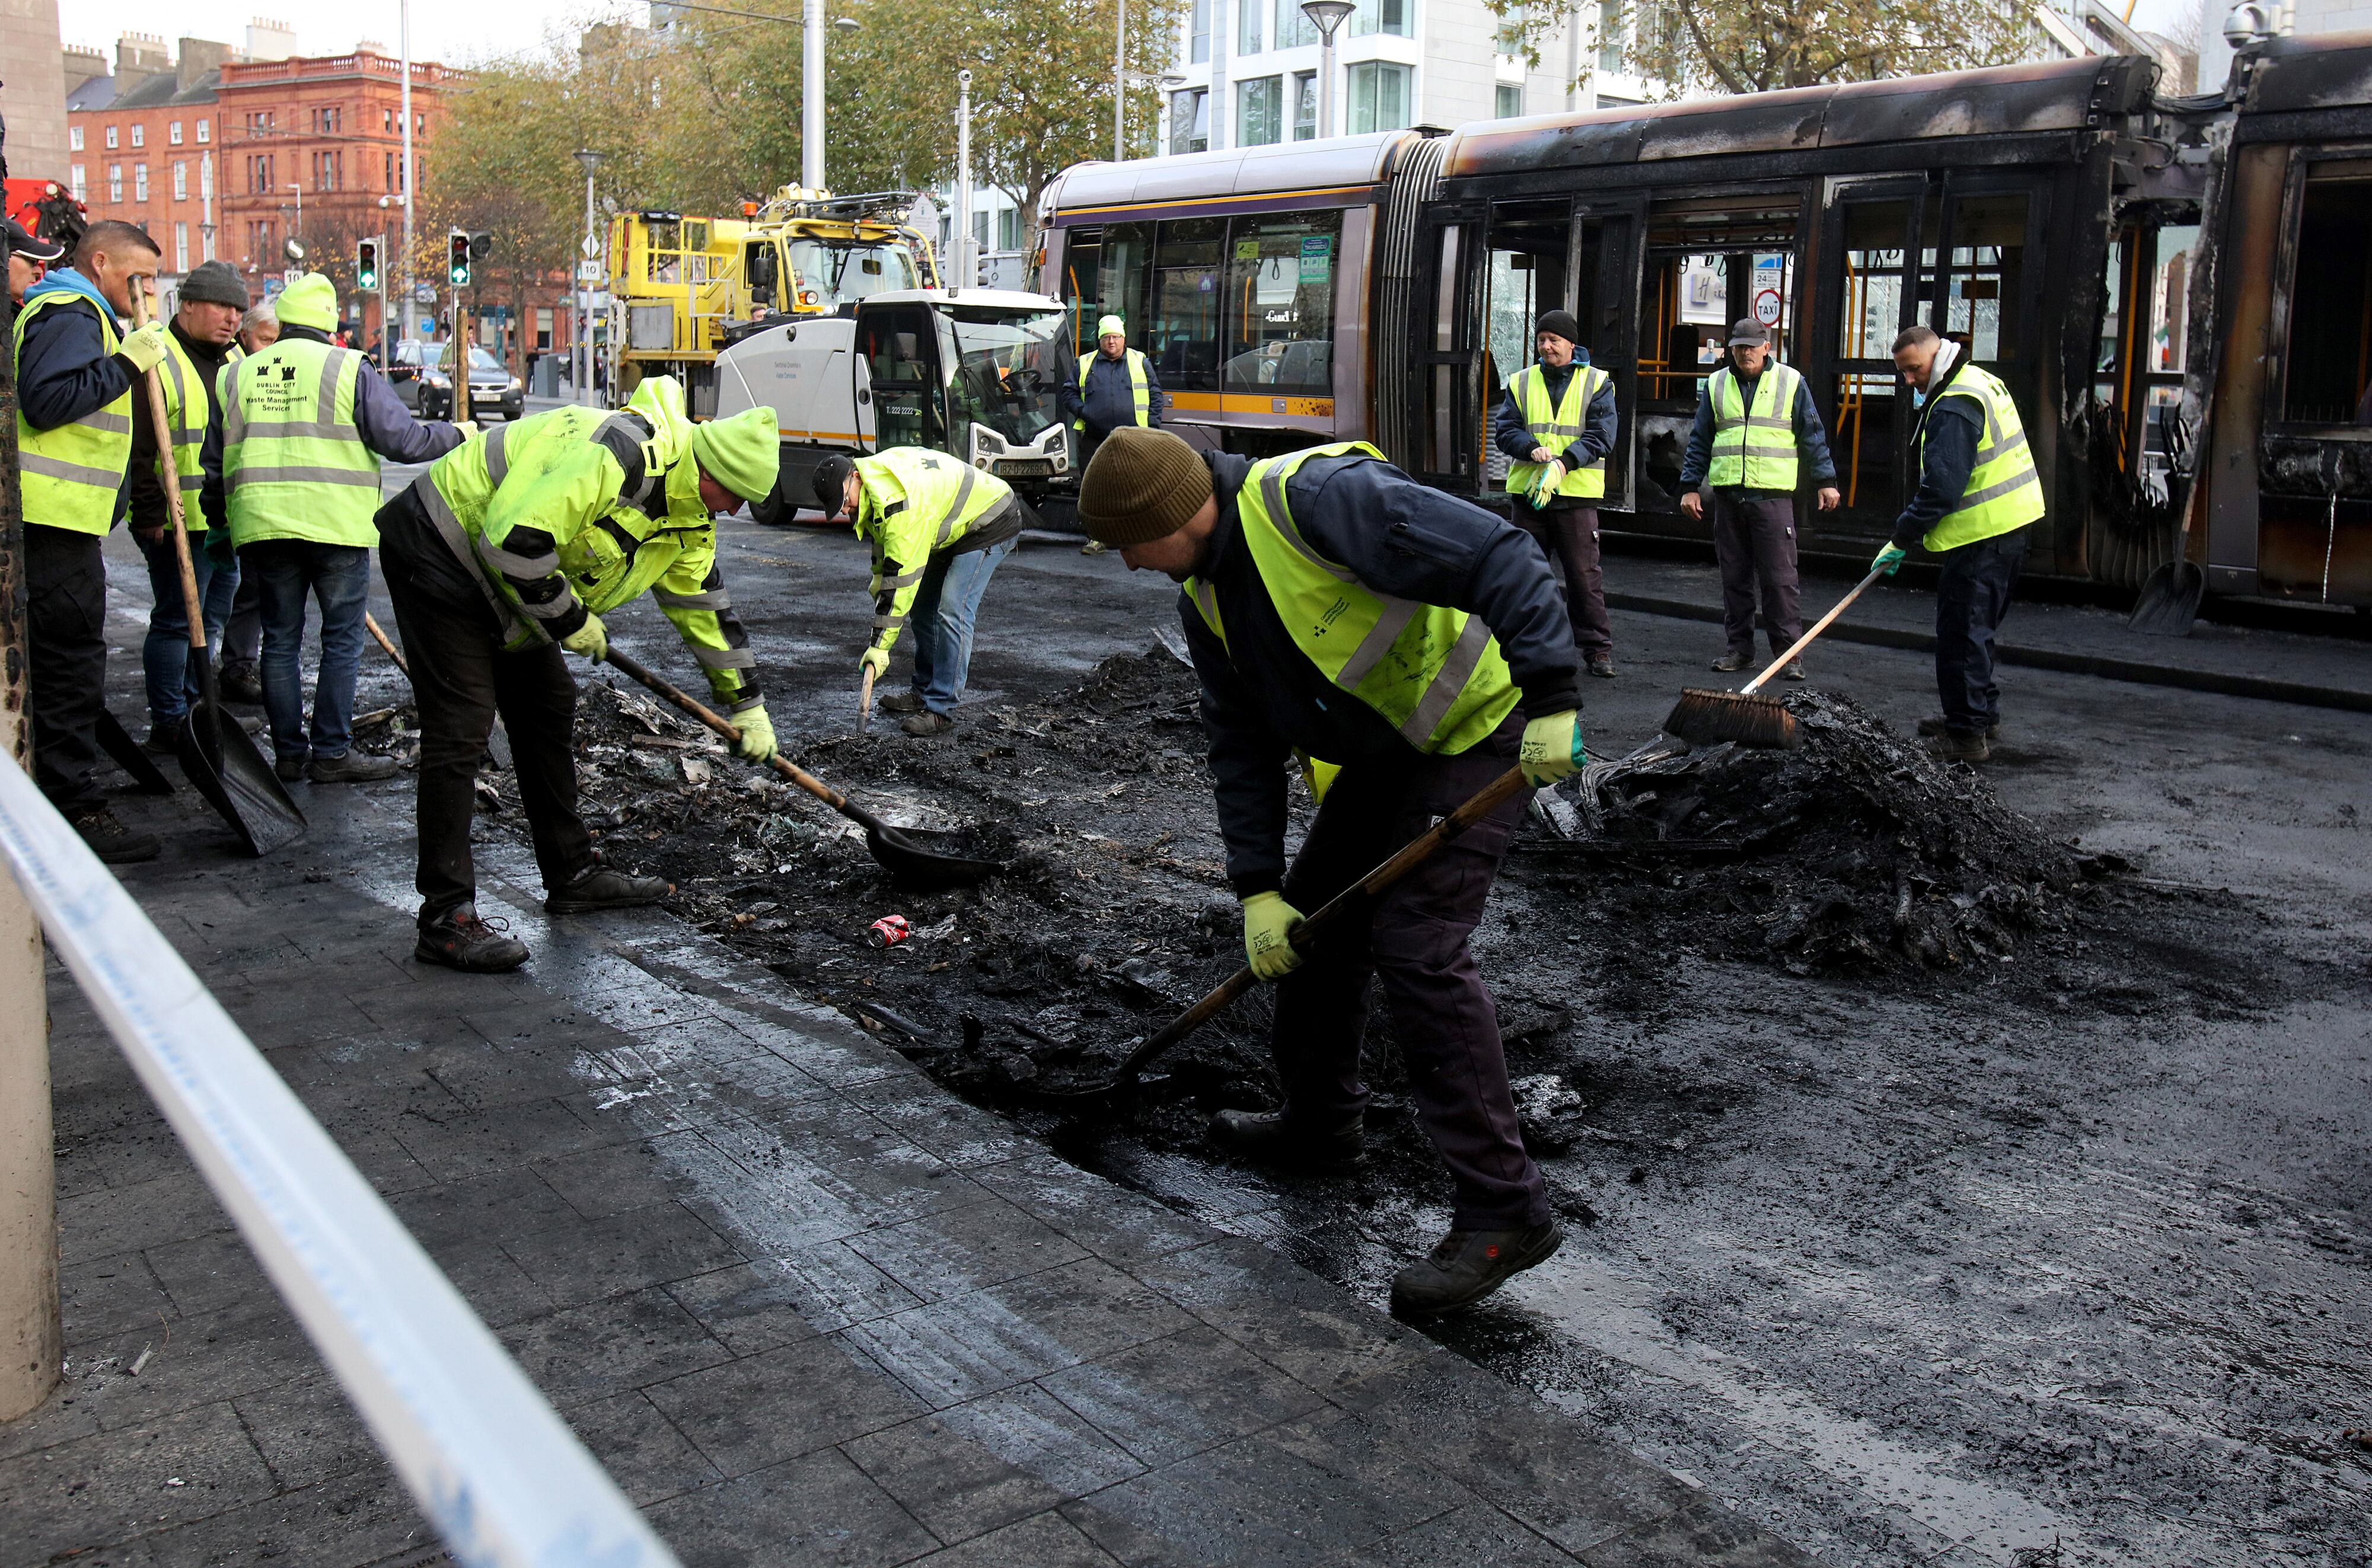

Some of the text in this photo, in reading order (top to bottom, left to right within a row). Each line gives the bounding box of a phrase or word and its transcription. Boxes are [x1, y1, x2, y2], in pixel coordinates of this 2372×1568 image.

[585, 266, 597, 274] 10
[287, 273, 300, 283] 10
[1758, 305, 1777, 315] TAXI
[267, 395, 307, 404] Management
[1000, 464, 1044, 475] 182-D-22695
